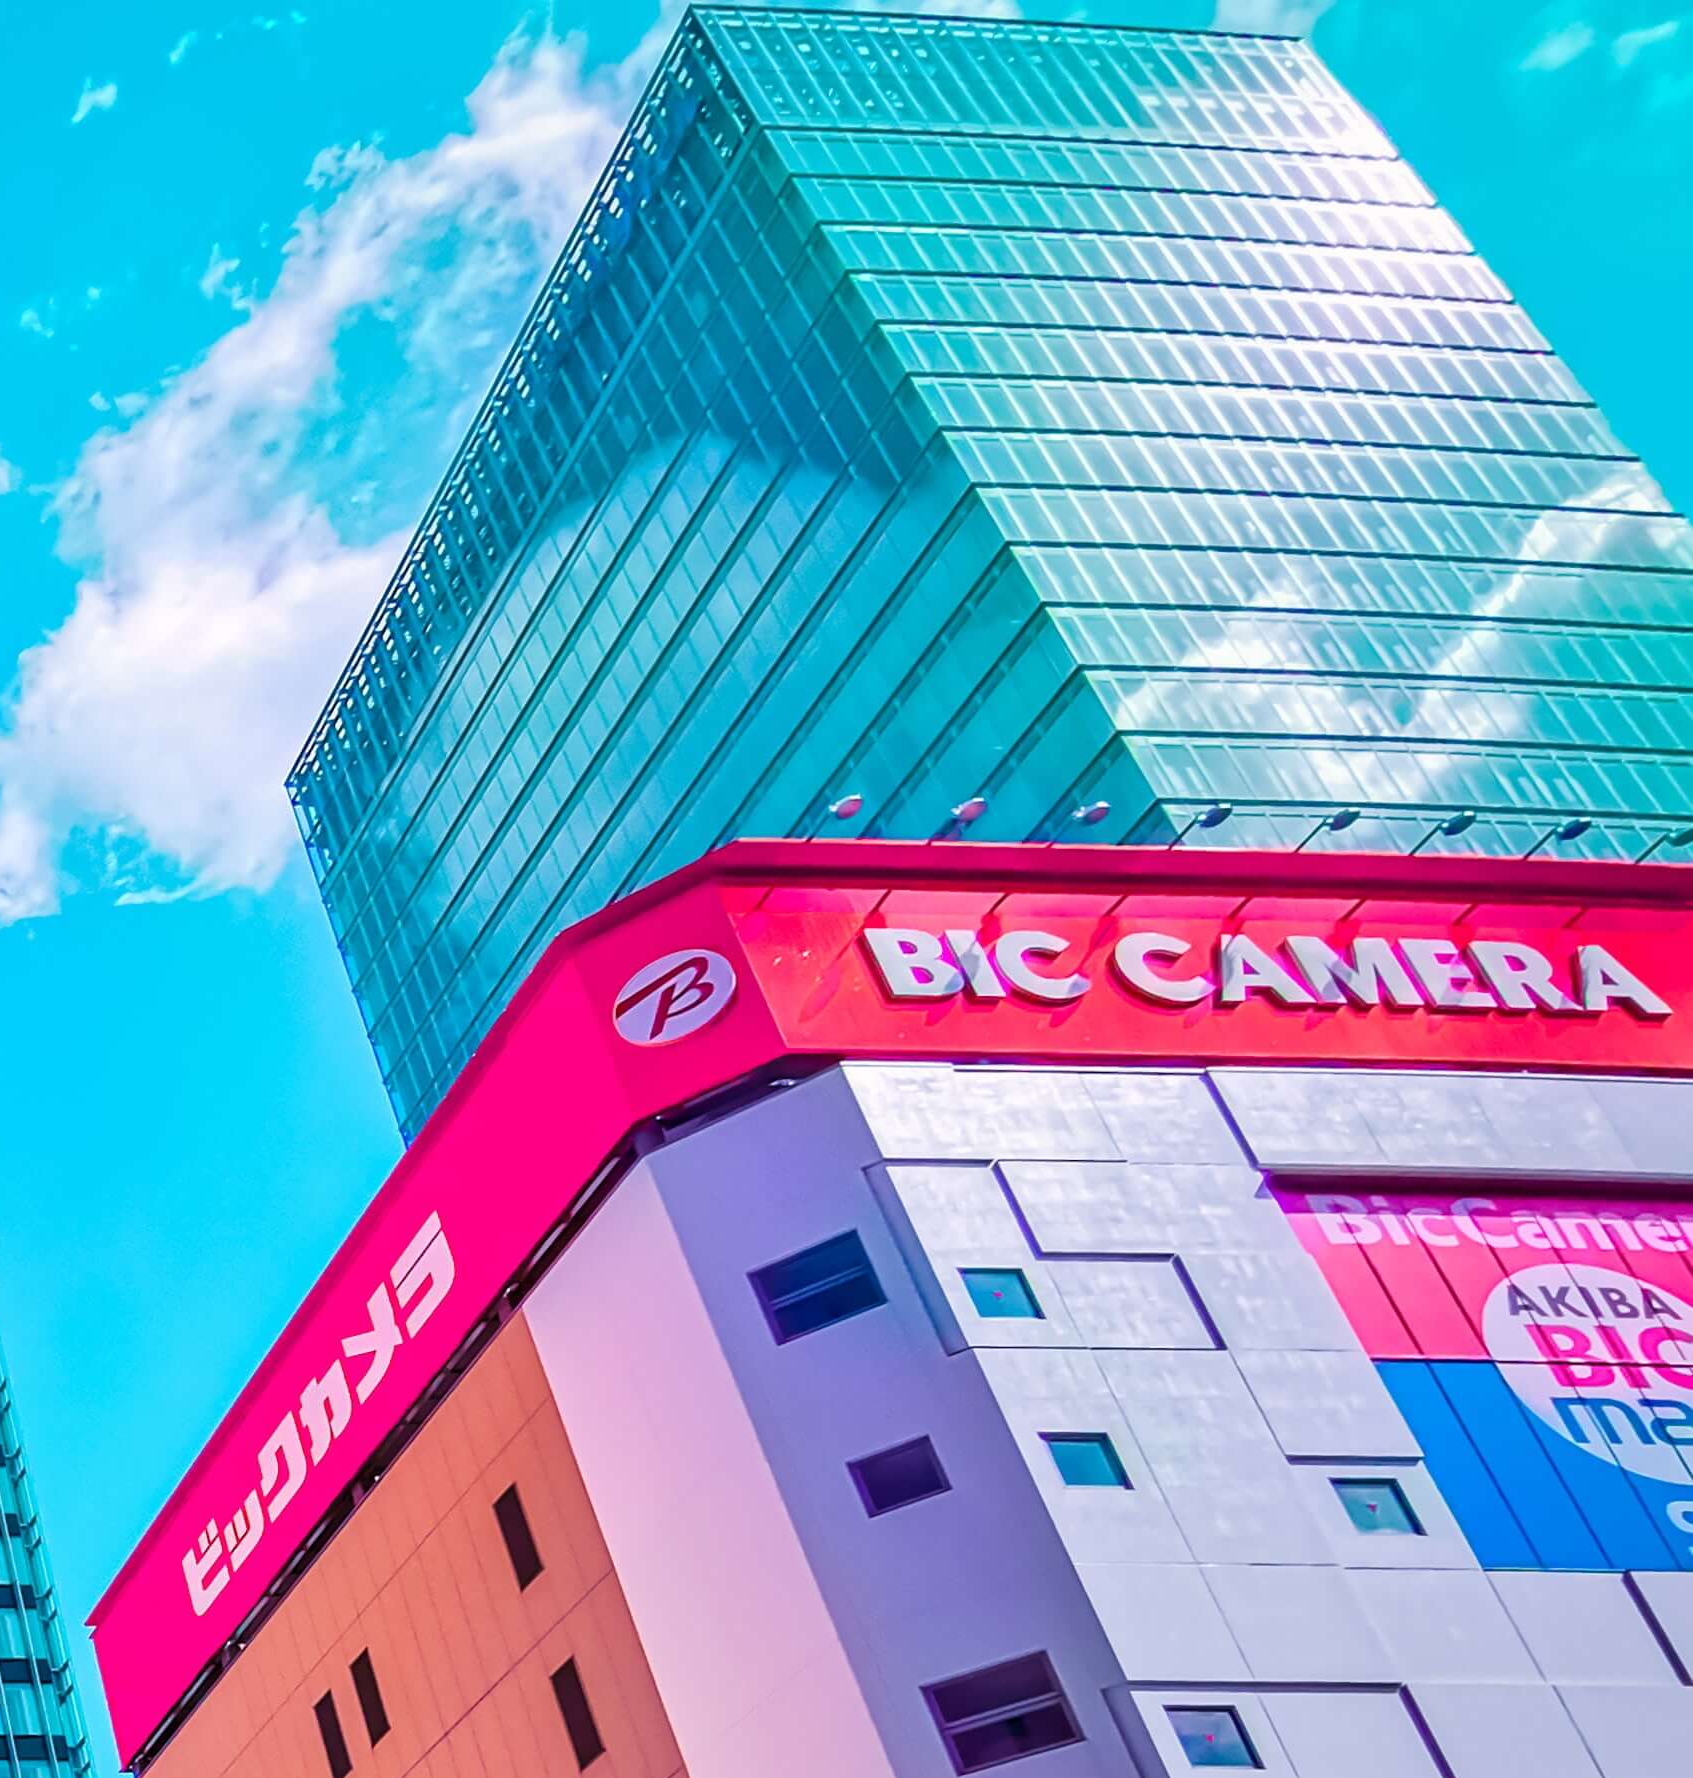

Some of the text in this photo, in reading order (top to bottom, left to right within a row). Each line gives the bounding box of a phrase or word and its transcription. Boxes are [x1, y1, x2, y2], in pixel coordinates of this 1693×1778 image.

[864, 928, 1672, 1020] BIC CAMERA
[1506, 1284, 1684, 1320] AKIBA
[180, 1209, 456, 1618] ビックカメラ
